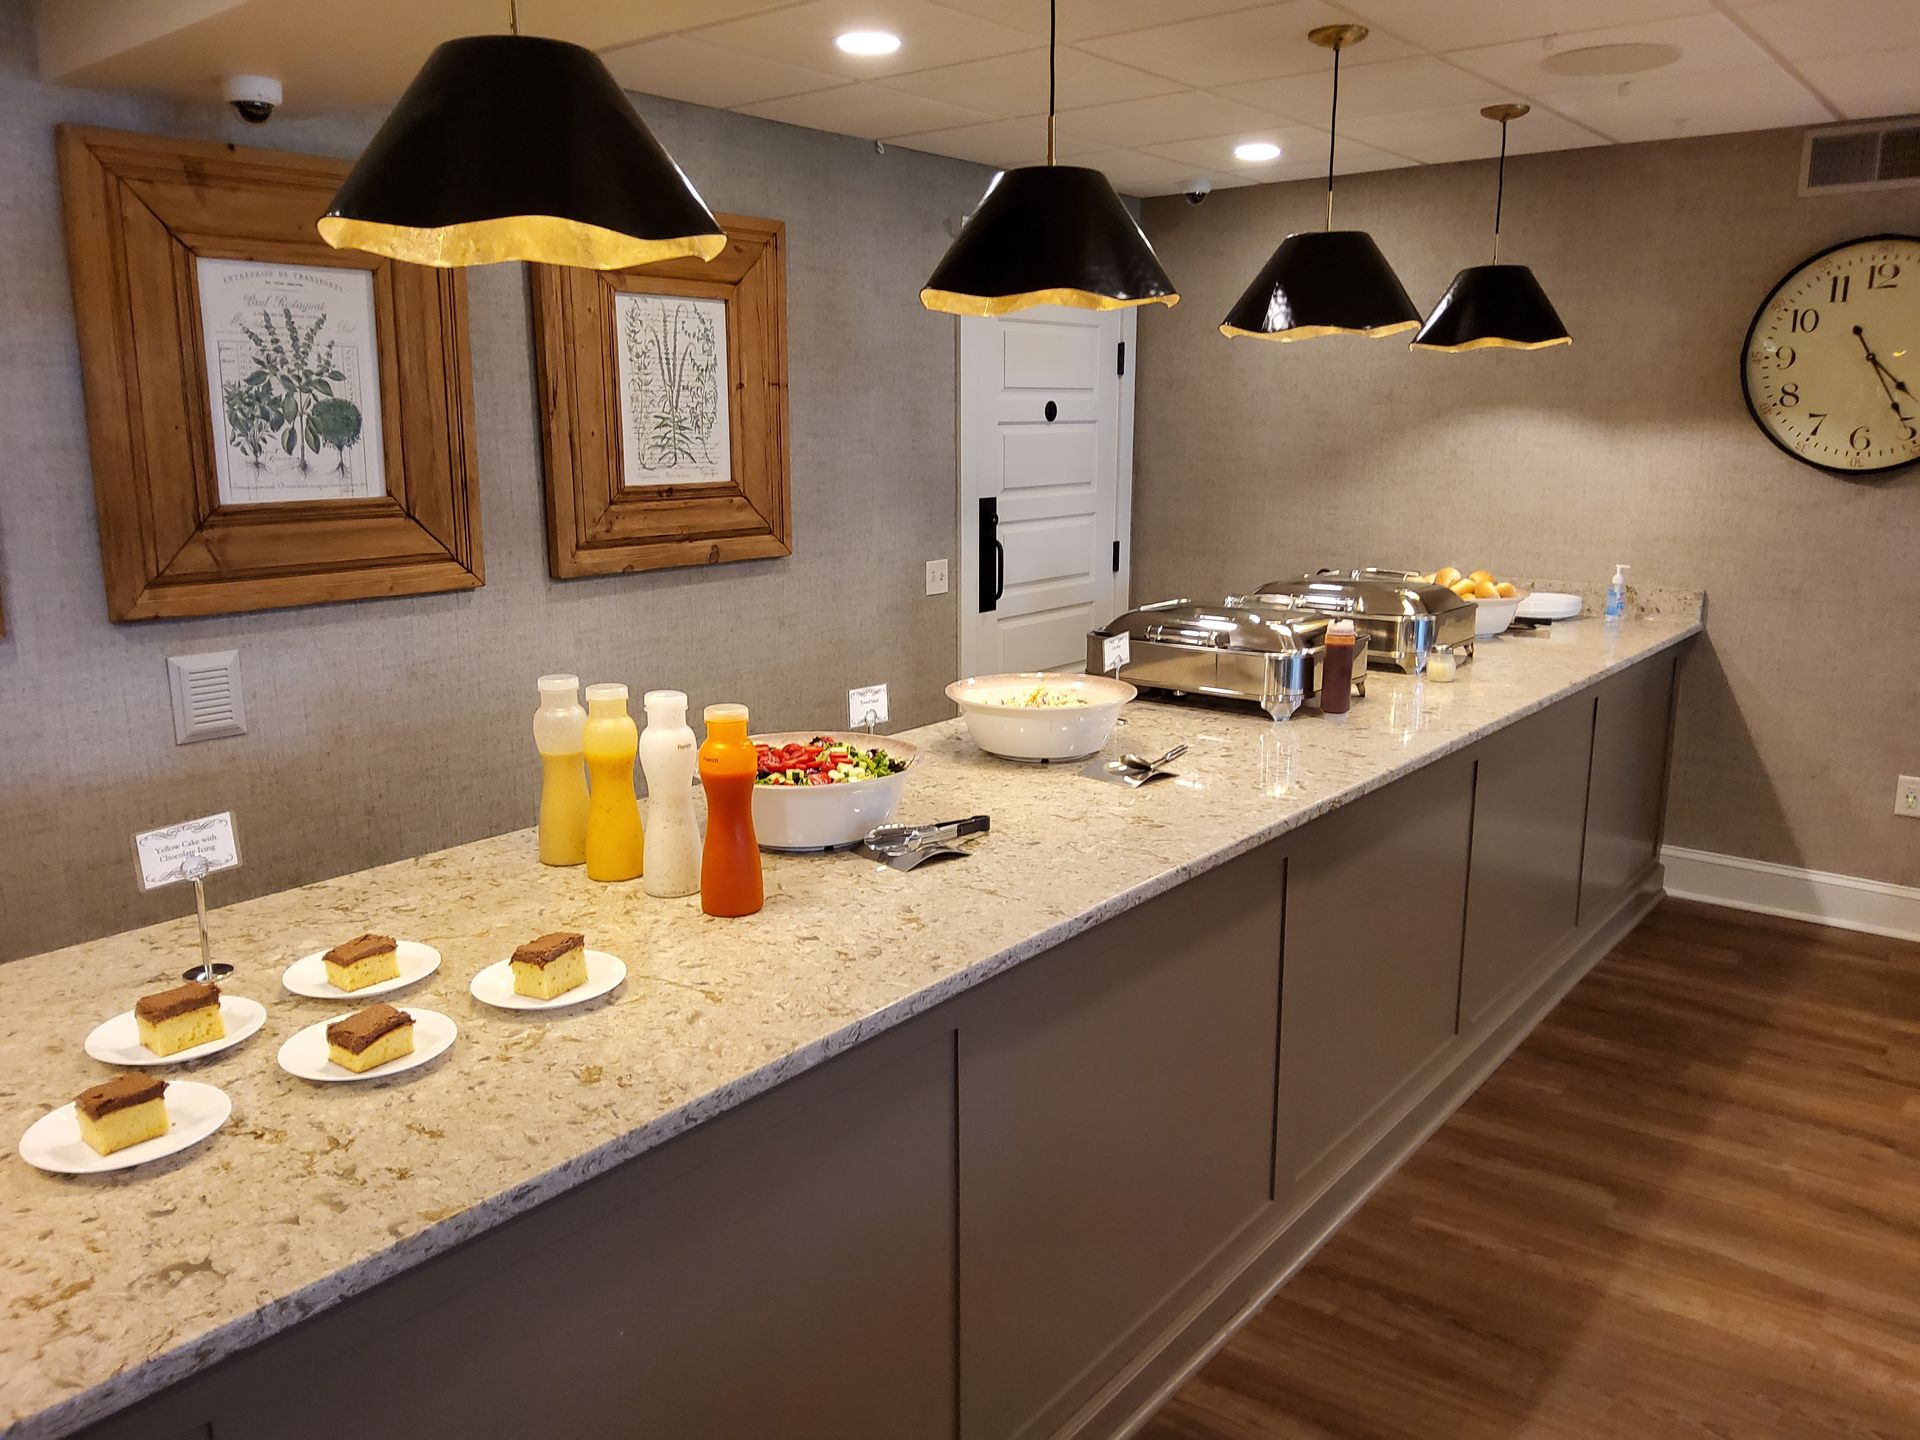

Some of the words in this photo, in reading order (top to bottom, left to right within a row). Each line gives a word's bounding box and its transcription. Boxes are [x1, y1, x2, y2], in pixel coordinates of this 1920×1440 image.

[1829, 275, 1850, 303] 11
[1867, 263, 1900, 290] 12
[1791, 308, 1820, 333] 10
[1775, 345, 1796, 370] 9
[1779, 382, 1800, 408] 8
[1808, 412, 1828, 436] 7
[1849, 425, 1871, 451] 6
[155, 844, 180, 855] Yellow
[181, 838, 200, 848] Cake
[201, 834, 217, 843] with
[197, 844, 216, 854] Icing
